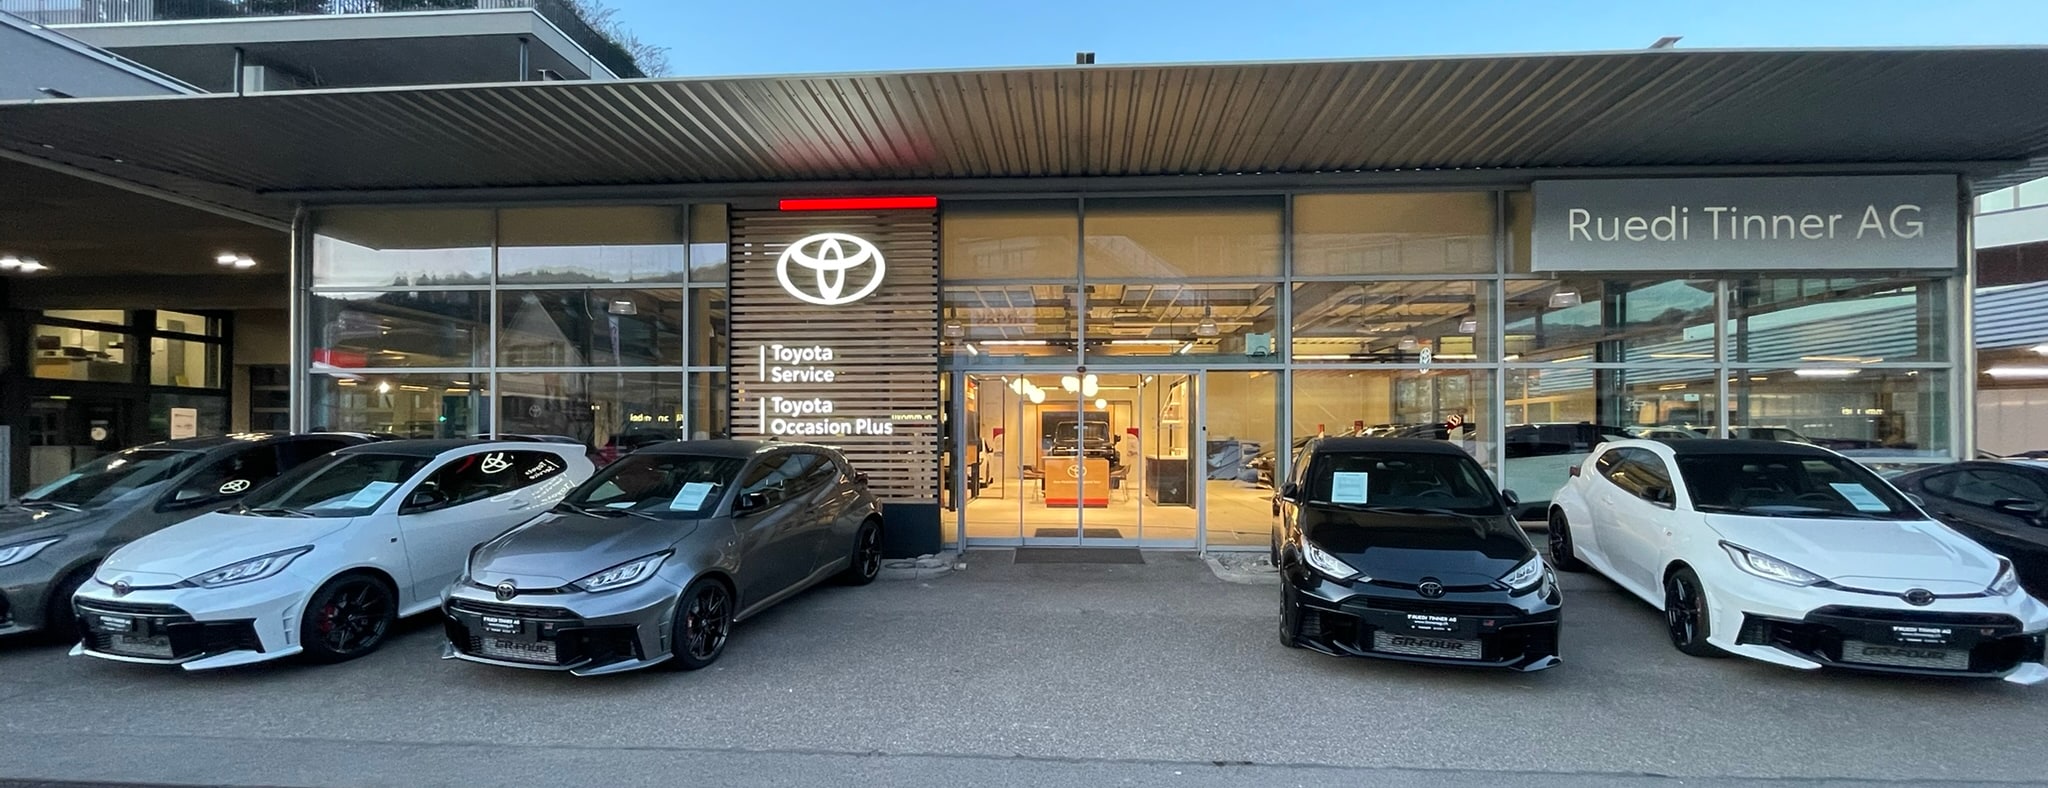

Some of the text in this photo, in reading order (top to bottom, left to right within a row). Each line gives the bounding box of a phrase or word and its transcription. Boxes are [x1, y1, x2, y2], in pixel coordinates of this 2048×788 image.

[1568, 204, 1925, 241] Ruedi Tinner AG
[771, 344, 833, 365] Toyota
[771, 366, 835, 382] Service
[771, 396, 833, 417] Toyota
[771, 418, 893, 435] Occasion Plus
